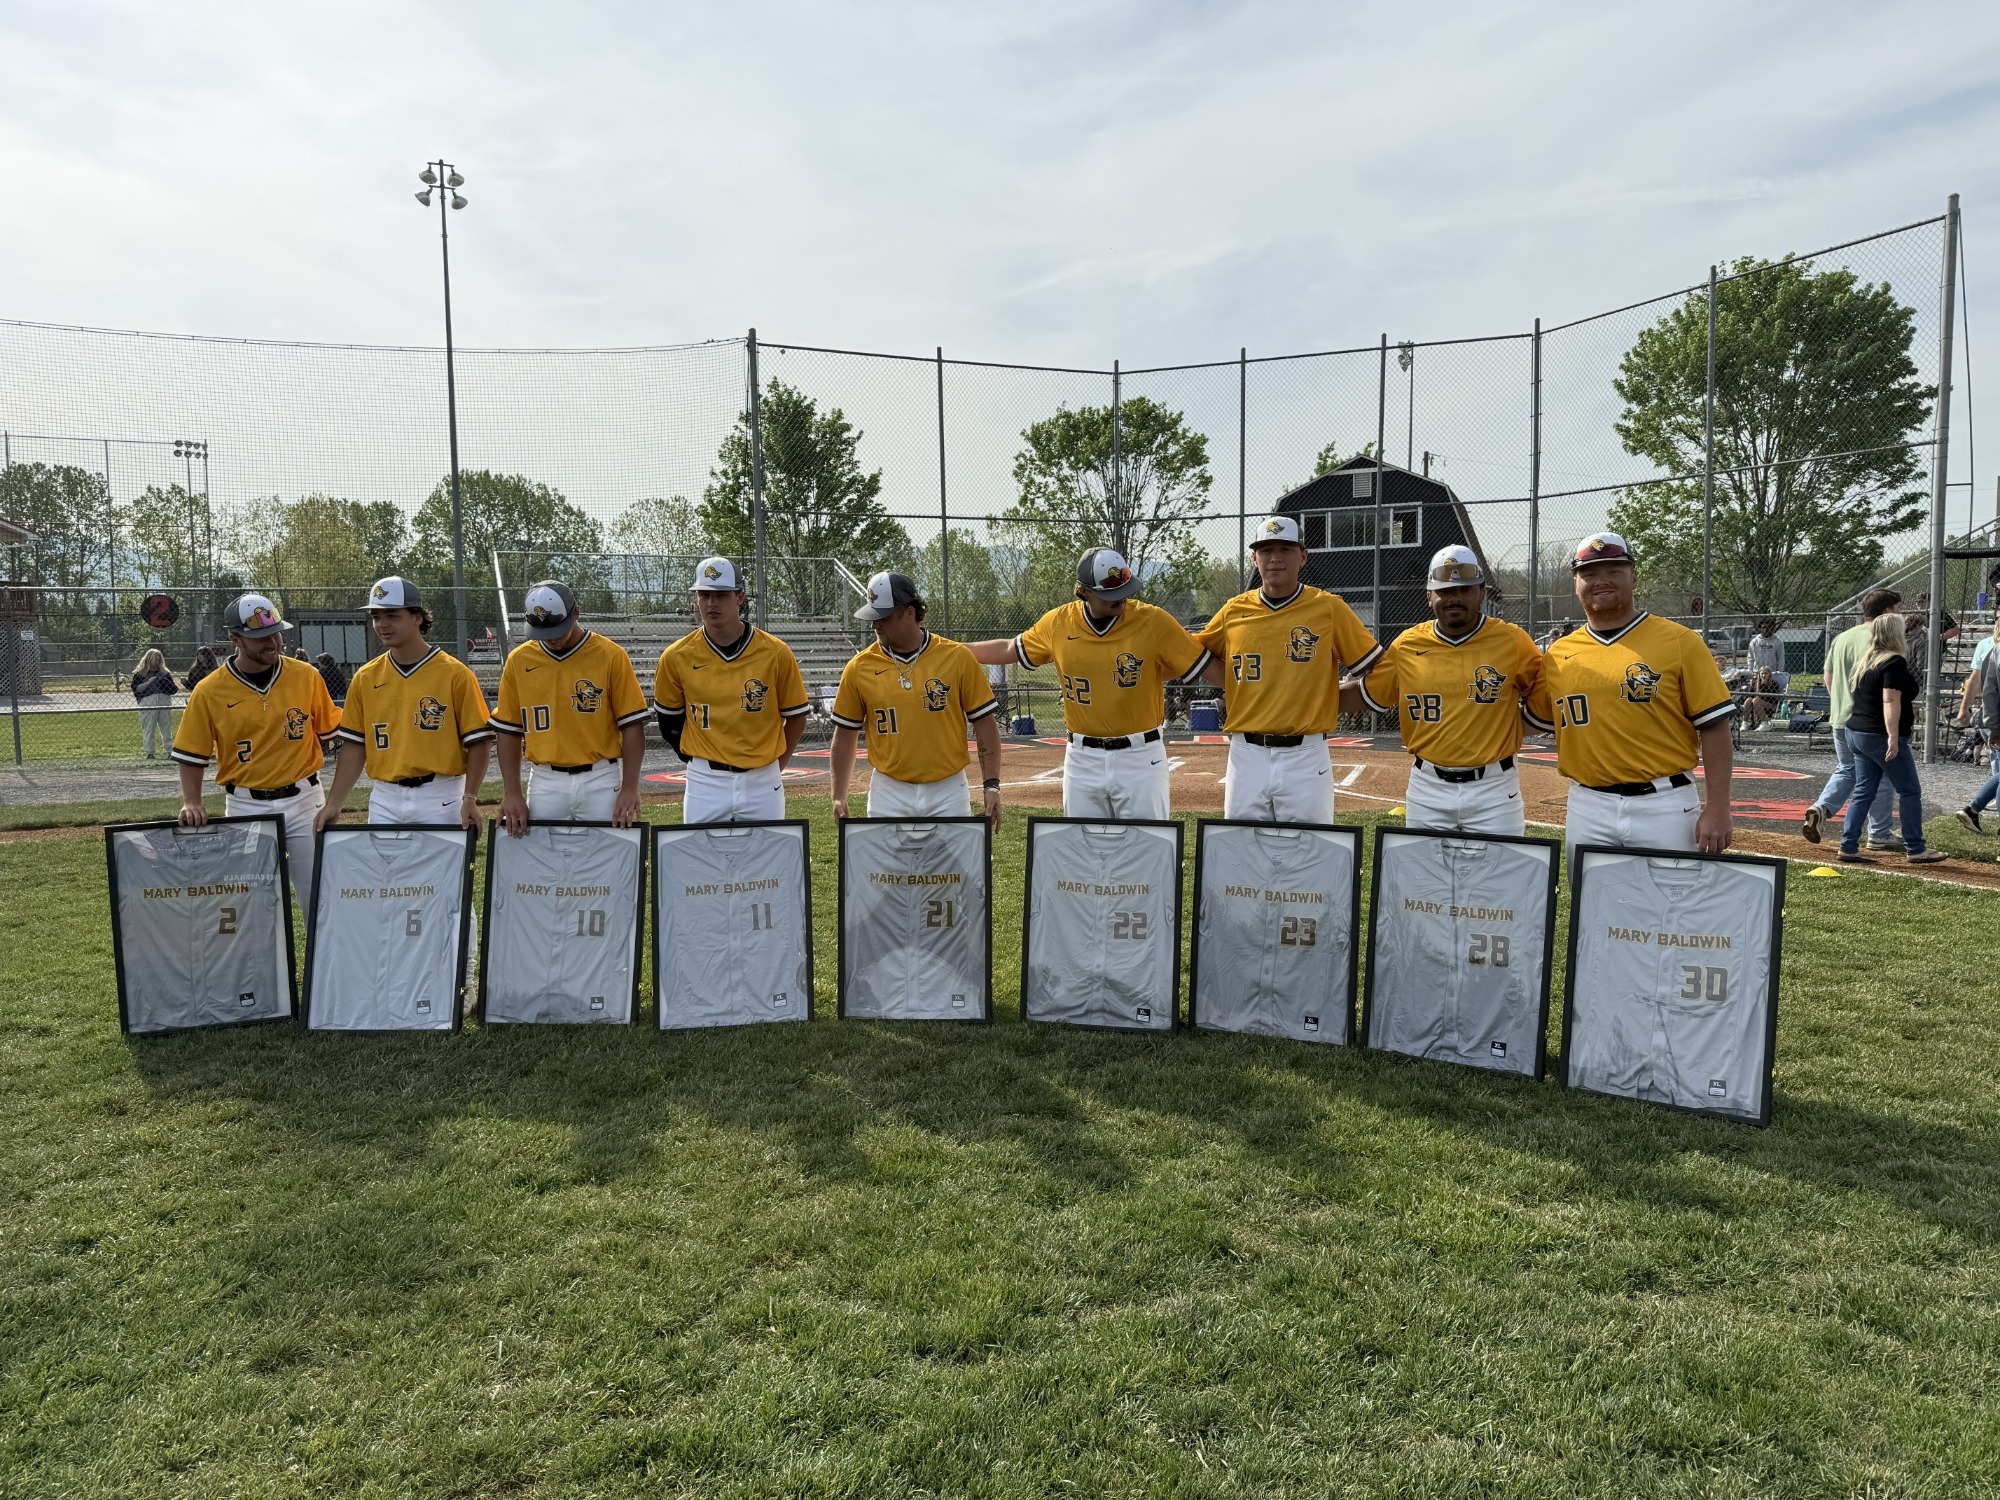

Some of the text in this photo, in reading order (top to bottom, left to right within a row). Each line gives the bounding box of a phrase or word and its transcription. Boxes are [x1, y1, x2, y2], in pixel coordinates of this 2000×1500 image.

[149, 596, 171, 627] 2
[1231, 652, 1262, 686] 23
[520, 705, 552, 734] 10
[874, 706, 900, 735] 21
[1404, 693, 1442, 724] 28
[372, 722, 390, 750] 6
[236, 738, 252, 764] 2
[143, 882, 249, 899] MARY BALDWIN
[340, 885, 435, 899] MARY BALDWIN
[515, 883, 611, 897] MARY BALDWIN
[685, 878, 779, 896] MARY BALDWIN
[869, 872, 961, 885] MARY BALDWIN
[1056, 880, 1150, 896] MARY BALDWIN
[1224, 884, 1323, 904] MARY BALDWIN
[218, 907, 237, 935] 2
[406, 909, 422, 937] 6
[576, 909, 606, 937] 10
[750, 902, 774, 931] 11
[926, 900, 955, 928] 21
[1403, 898, 1514, 922] MARY BALDWIN
[1113, 911, 1148, 940] 22
[1280, 916, 1317, 947] 23
[1607, 926, 1732, 949] MARY BALDWIN
[1468, 933, 1510, 968] 28
[1680, 964, 1729, 1002] 30
